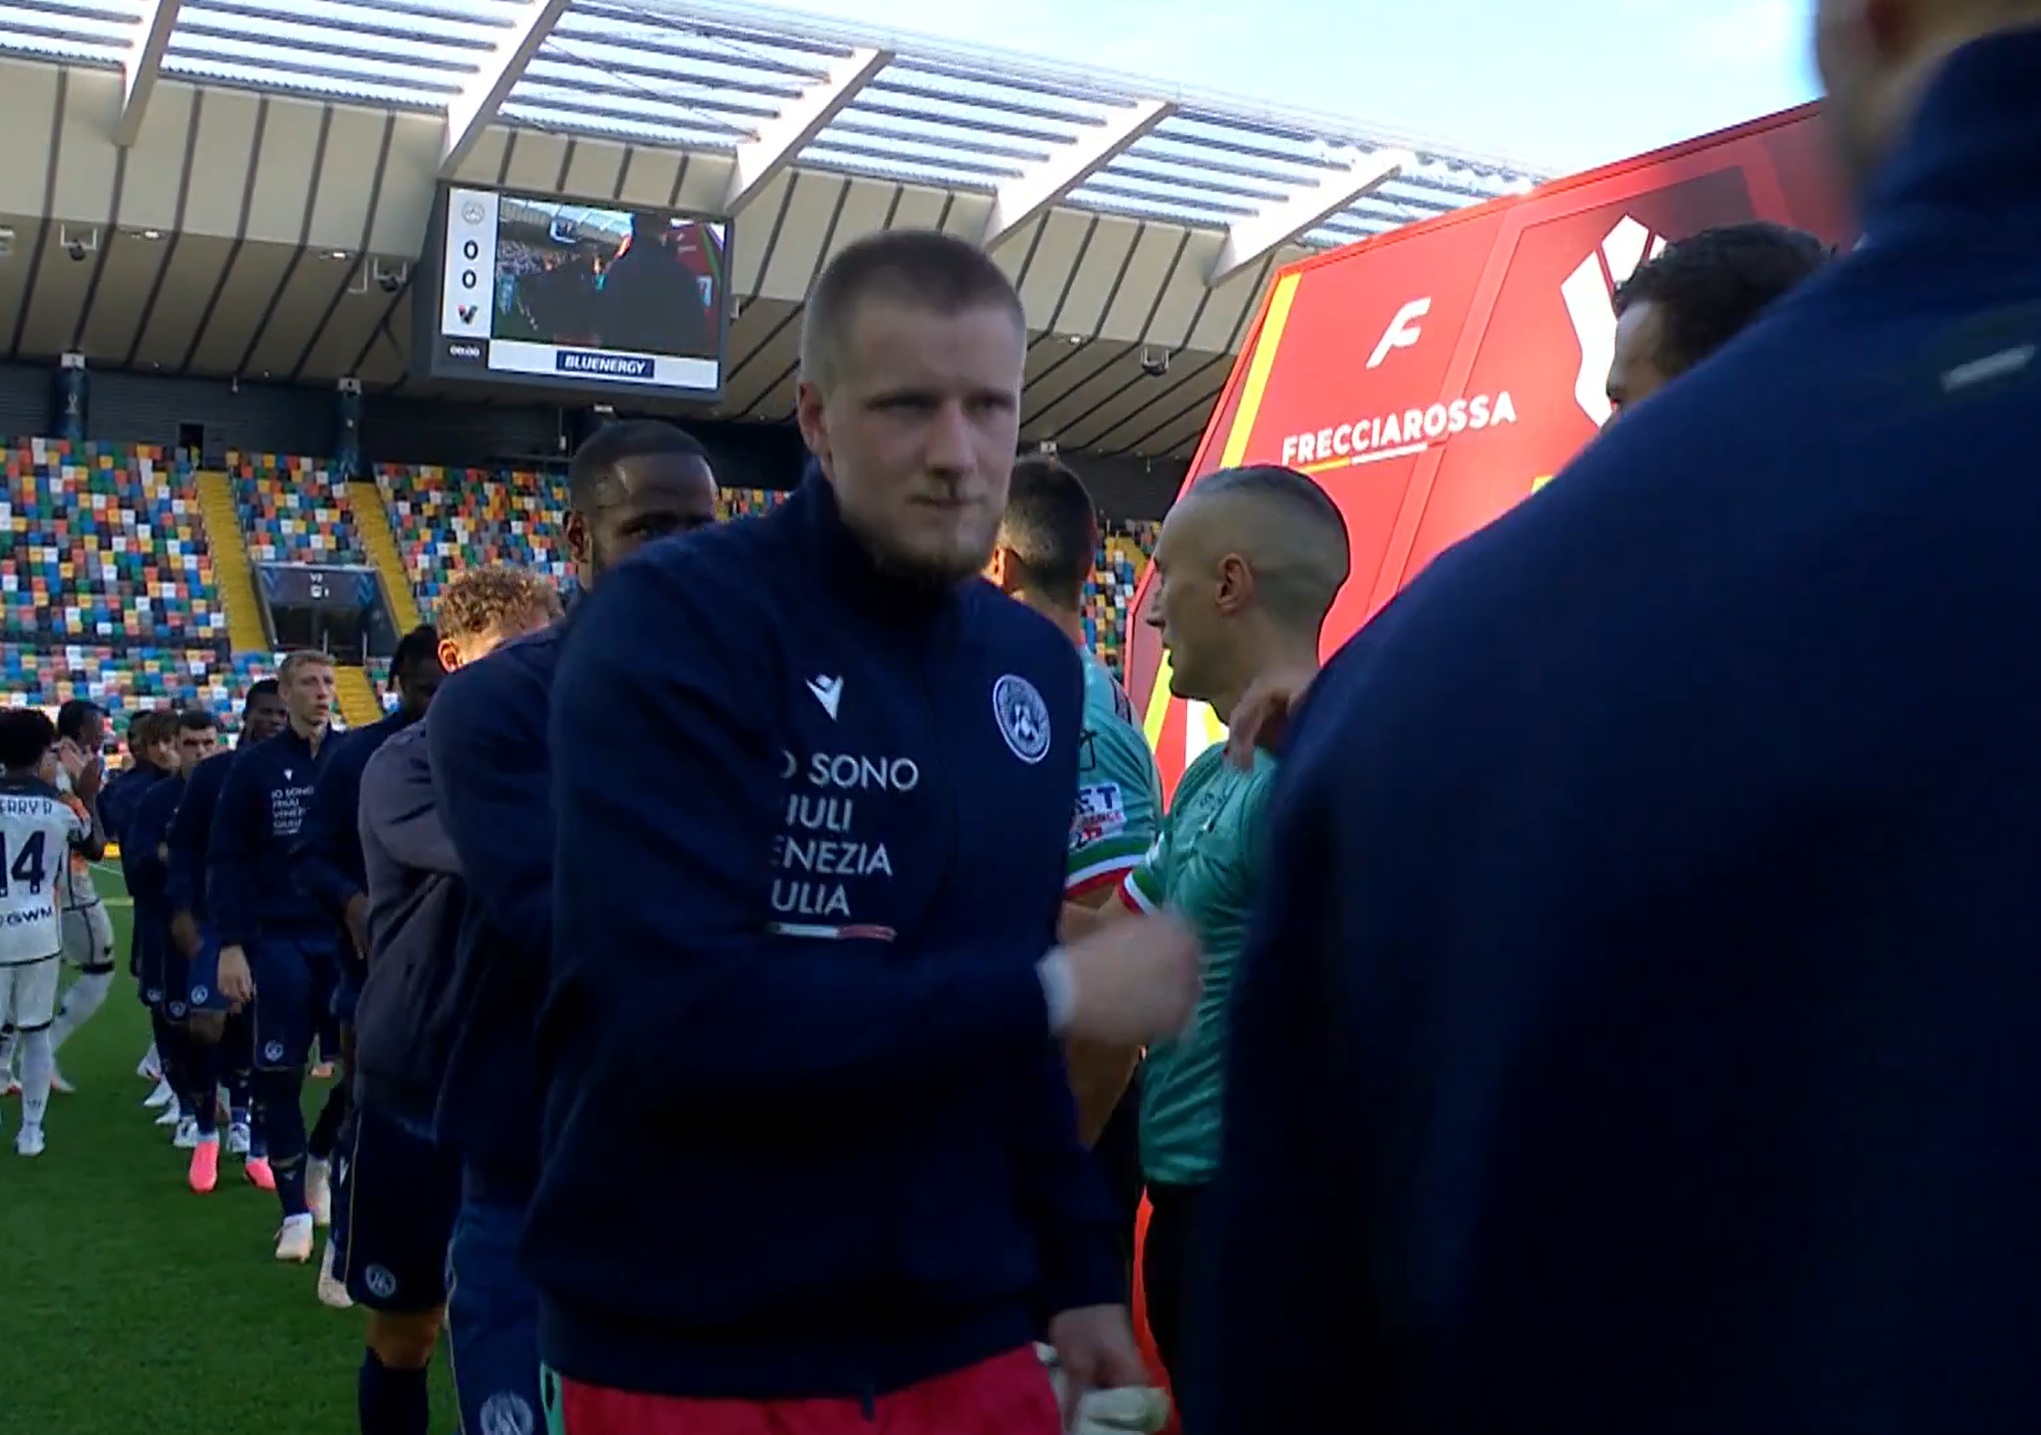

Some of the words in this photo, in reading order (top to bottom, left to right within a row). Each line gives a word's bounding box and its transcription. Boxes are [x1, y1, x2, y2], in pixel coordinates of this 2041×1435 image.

[463, 240, 479, 261] 0
[462, 269, 477, 290] 0
[564, 354, 646, 375] BLUENERGY
[1281, 390, 1517, 467] FRECCIAROSSA
[807, 752, 920, 792] SONO
[0, 830, 45, 897] 14
